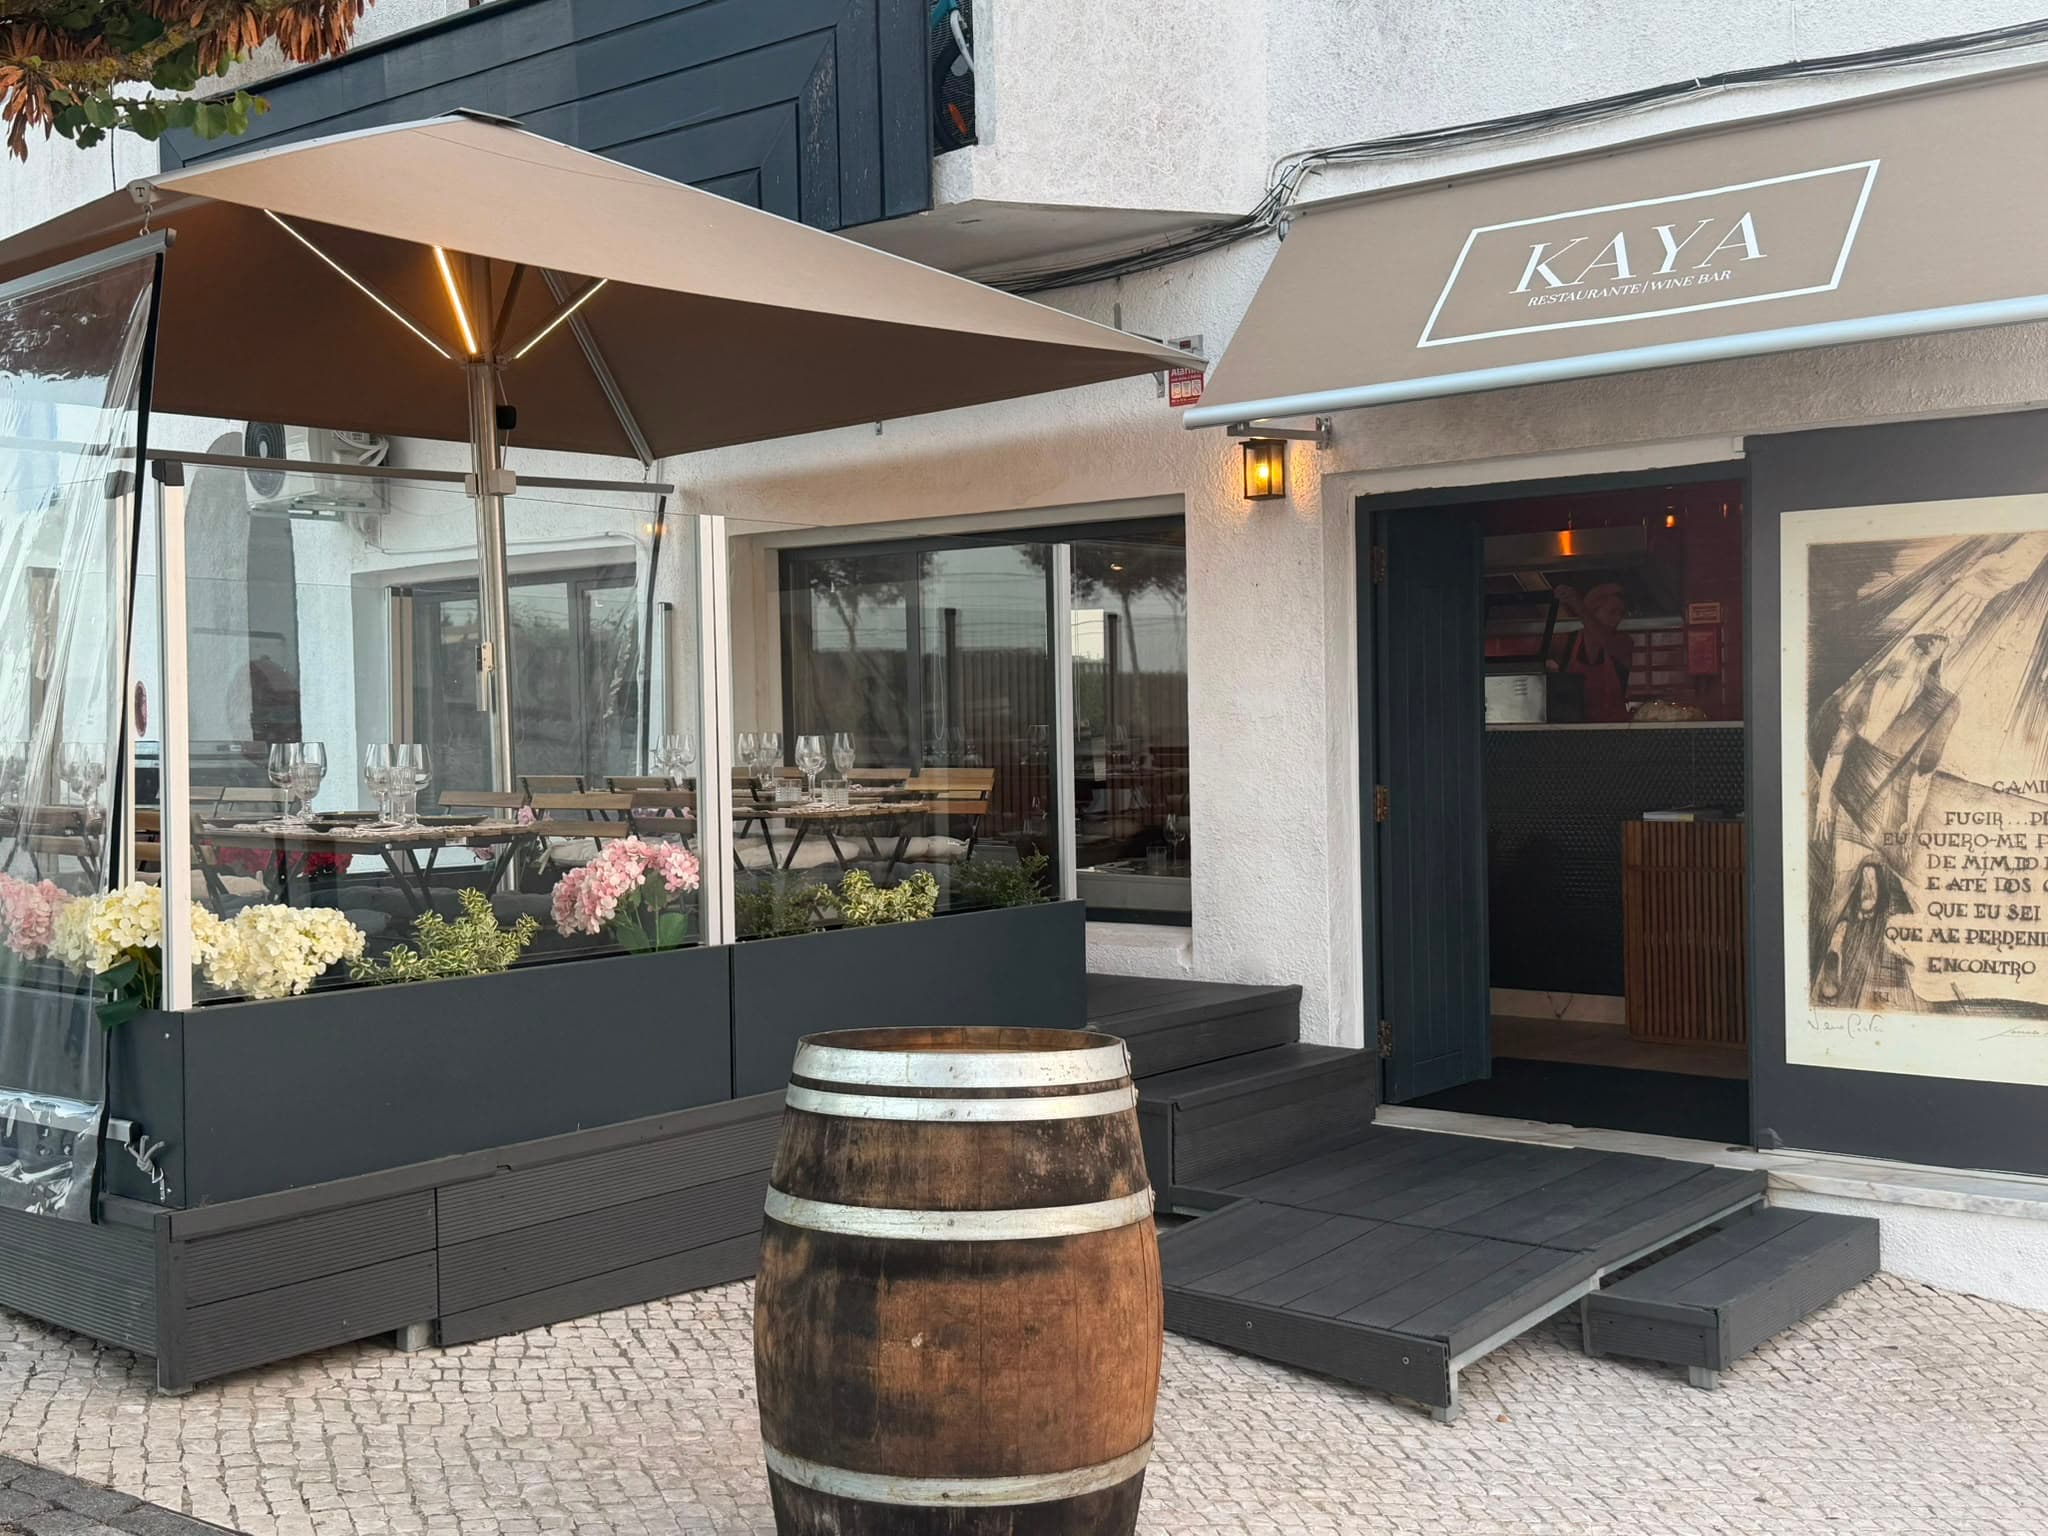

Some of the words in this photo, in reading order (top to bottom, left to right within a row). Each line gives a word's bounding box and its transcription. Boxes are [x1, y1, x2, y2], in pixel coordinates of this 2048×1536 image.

[1509, 211, 1768, 295] KAYA
[1697, 269, 1732, 285] BAR
[1883, 832, 1907, 846] EU
[1918, 832, 2027, 853] QUERO-ME
[1926, 853, 1956, 870] DE
[1925, 876, 1940, 890] E
[1993, 876, 2031, 894] DOS
[1927, 901, 1968, 920] QUE
[1973, 903, 2000, 919] EU
[2007, 903, 2042, 921] SEI
[1885, 927, 1922, 944] QUE
[1927, 927, 1960, 944] ME
[1926, 956, 2036, 984] ENCONTRO
